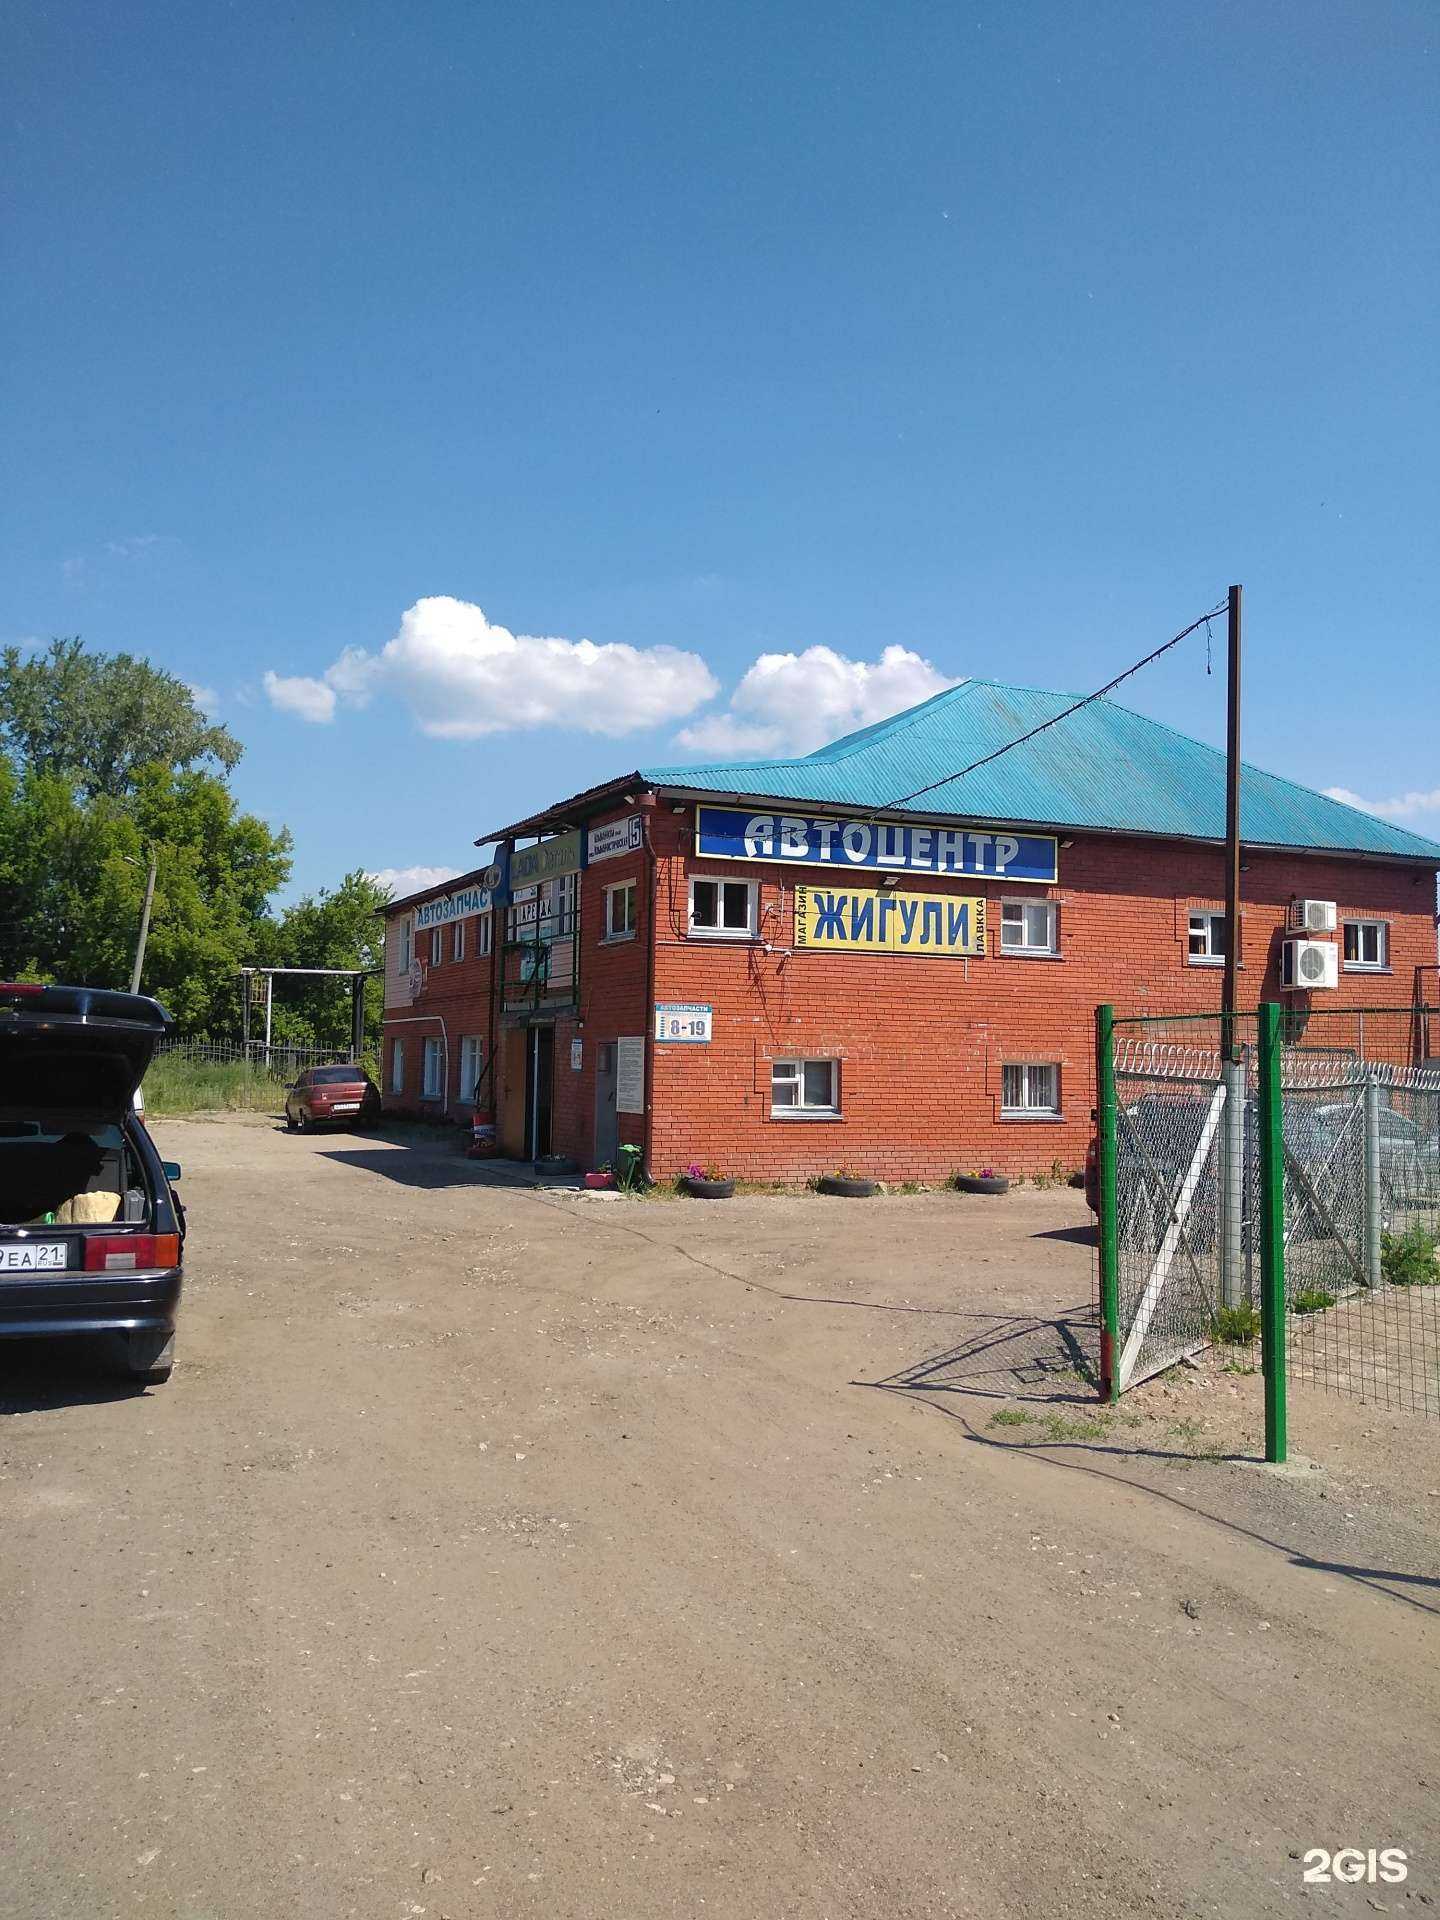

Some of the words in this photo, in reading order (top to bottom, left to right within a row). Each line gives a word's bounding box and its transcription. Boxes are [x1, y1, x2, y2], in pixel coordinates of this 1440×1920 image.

[744, 815, 1019, 872] АВТОЦЕНТР
[521, 899, 551, 921] АРЕДА
[798, 886, 807, 945] МАГАЗИН
[813, 893, 969, 947] ЖИГУЛИ
[976, 899, 985, 952] ЛАВККА
[39, 1246, 58, 1261] 21
